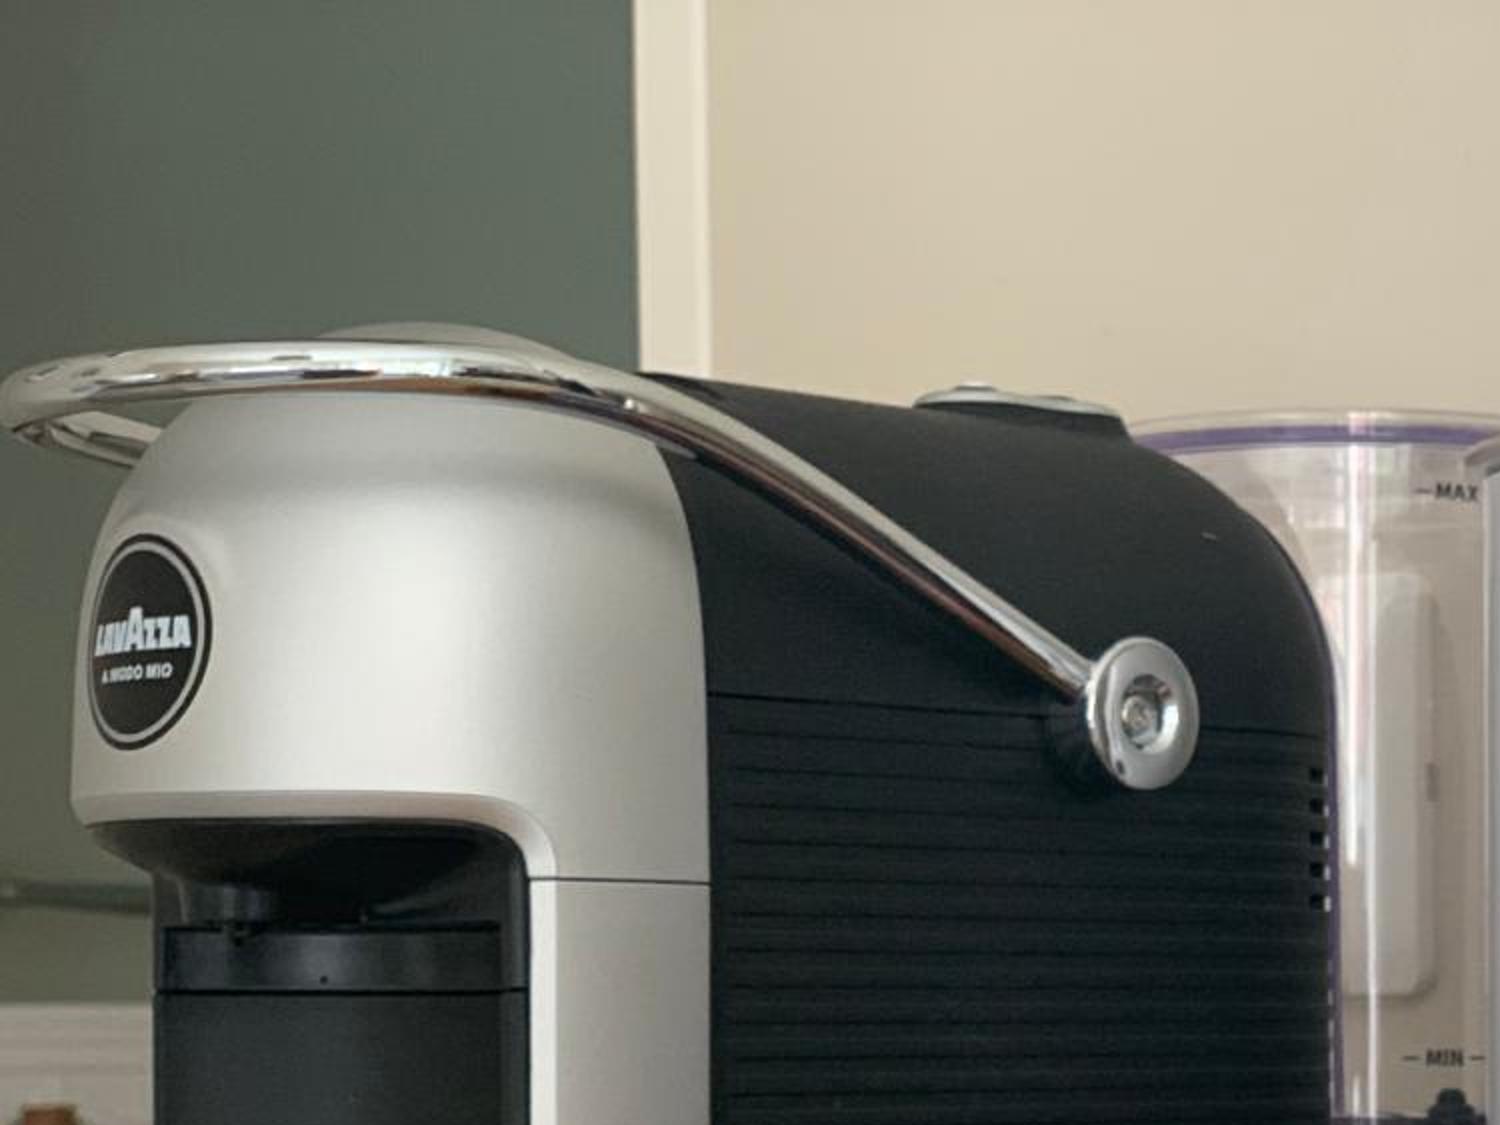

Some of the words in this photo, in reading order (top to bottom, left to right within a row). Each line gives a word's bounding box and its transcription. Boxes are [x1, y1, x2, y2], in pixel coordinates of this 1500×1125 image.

[1435, 483, 1479, 502] MAX
[95, 606, 193, 657] LAVAZZA
[101, 668, 109, 684] A
[110, 664, 143, 683] MODO
[146, 661, 174, 680] MIO
[1425, 1048, 1465, 1068] MIN
